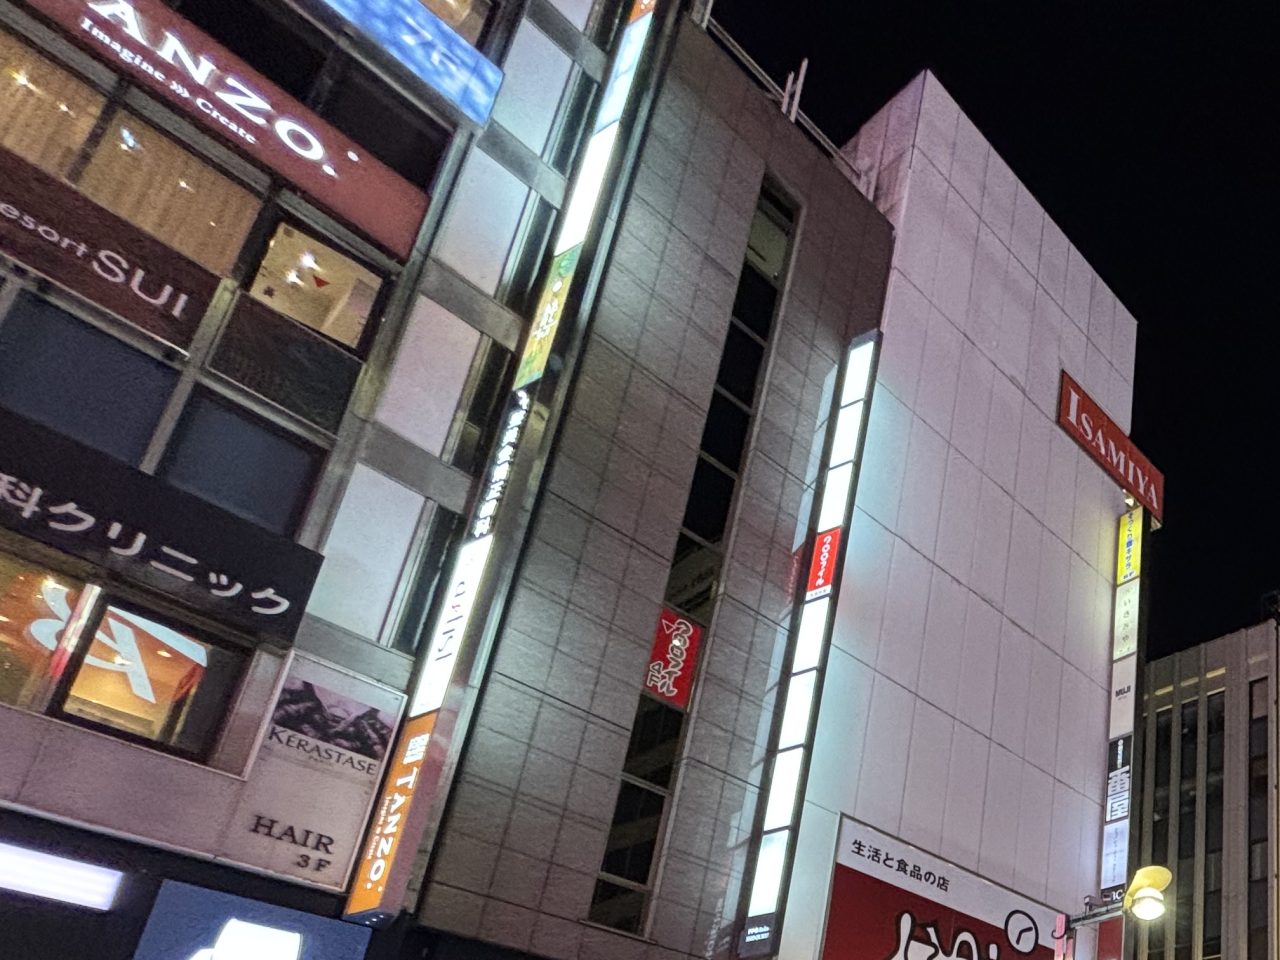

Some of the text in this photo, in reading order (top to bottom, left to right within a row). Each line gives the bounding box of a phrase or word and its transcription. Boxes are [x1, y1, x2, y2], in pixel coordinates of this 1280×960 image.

[92, 249, 189, 317] SUI
[1064, 388, 1160, 511] ISAMIYA
[1115, 684, 1132, 698] MUJI
[250, 813, 335, 855] HAIR
[295, 853, 333, 873] 3F
[851, 839, 951, 893] 生活と食品の店
